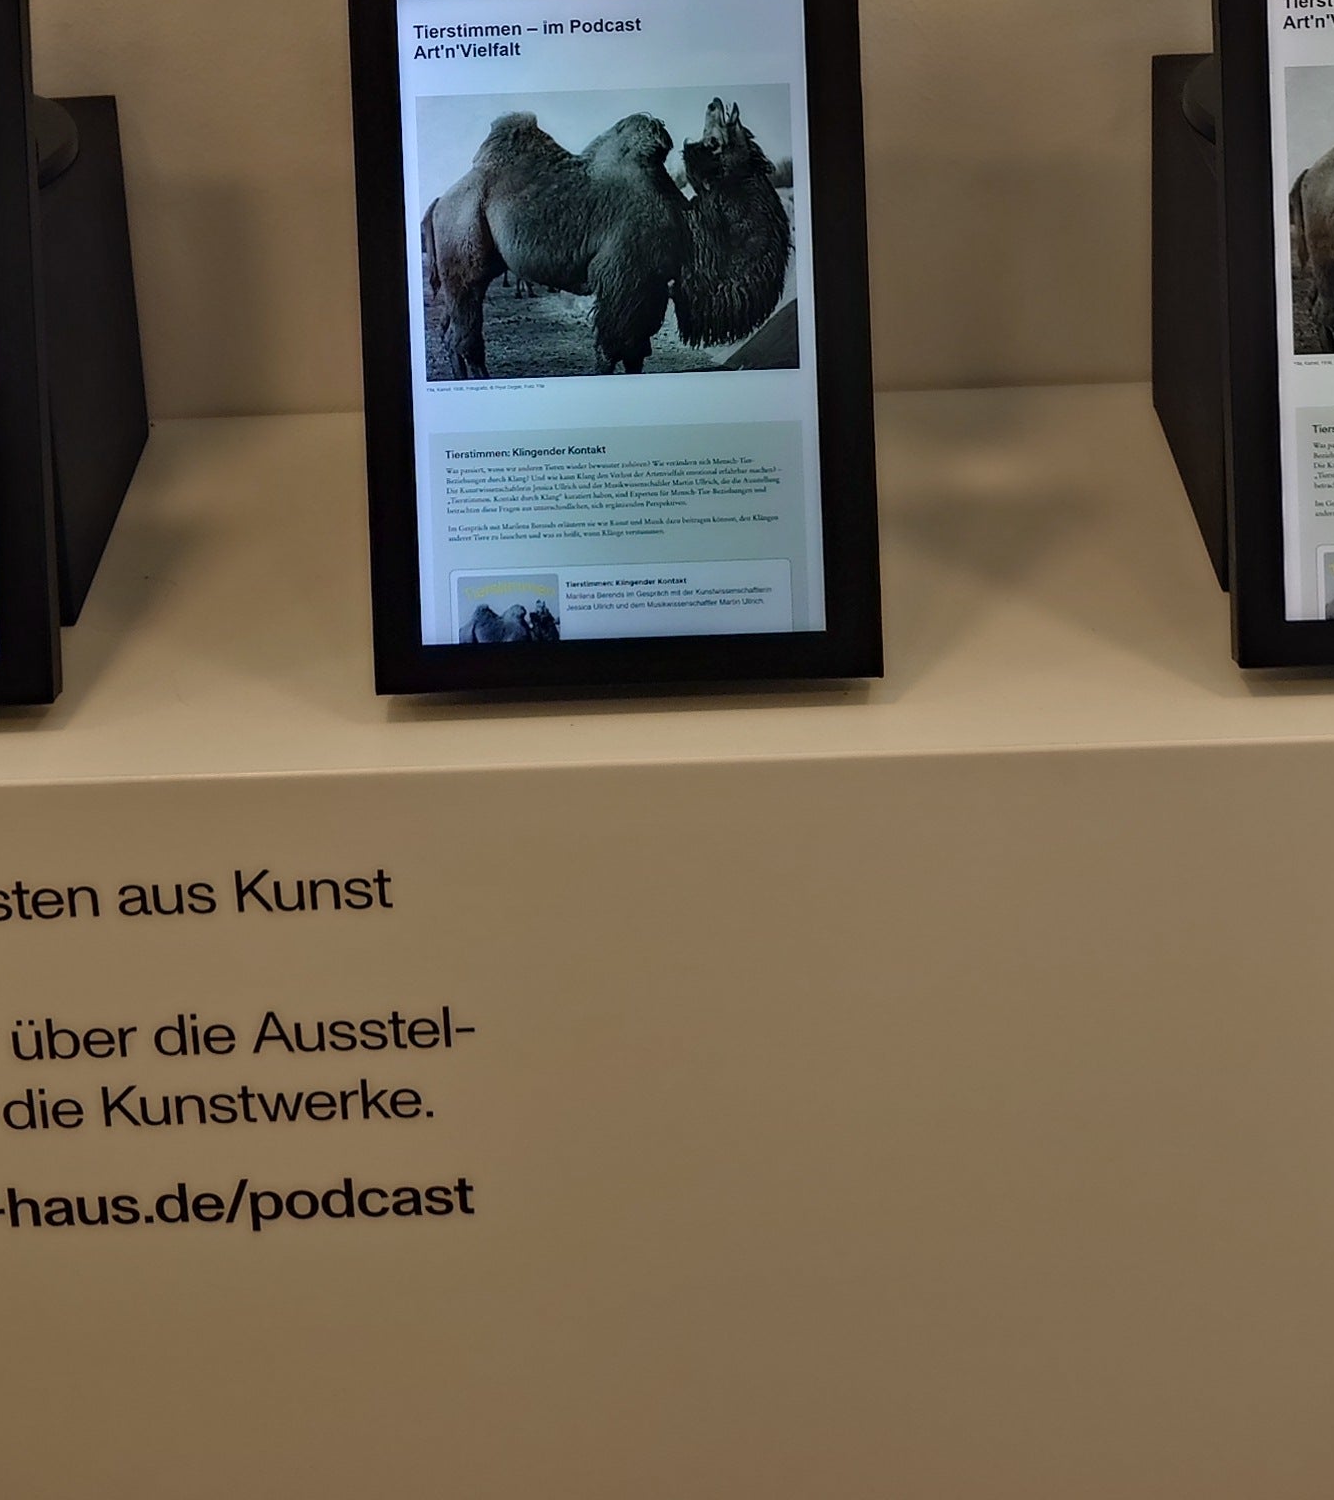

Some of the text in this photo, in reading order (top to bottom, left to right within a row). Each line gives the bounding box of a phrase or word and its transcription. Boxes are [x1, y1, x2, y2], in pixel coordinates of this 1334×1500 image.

[413, 23, 522, 39] Tierstimmen
[543, 20, 564, 35] im
[570, 17, 642, 34] Podcast
[413, 41, 521, 60] Art'n'Vielfalt
[445, 445, 606, 459] Tierstimmen: Klingender Kontakt
[118, 882, 217, 917] aus
[234, 869, 394, 913] Kunst
[11, 1017, 138, 1061] über
[154, 1013, 236, 1057] die
[252, 1005, 476, 1054] Ausstel-
[2, 1088, 84, 1130] die
[101, 1078, 434, 1127] Kunstwerke.
